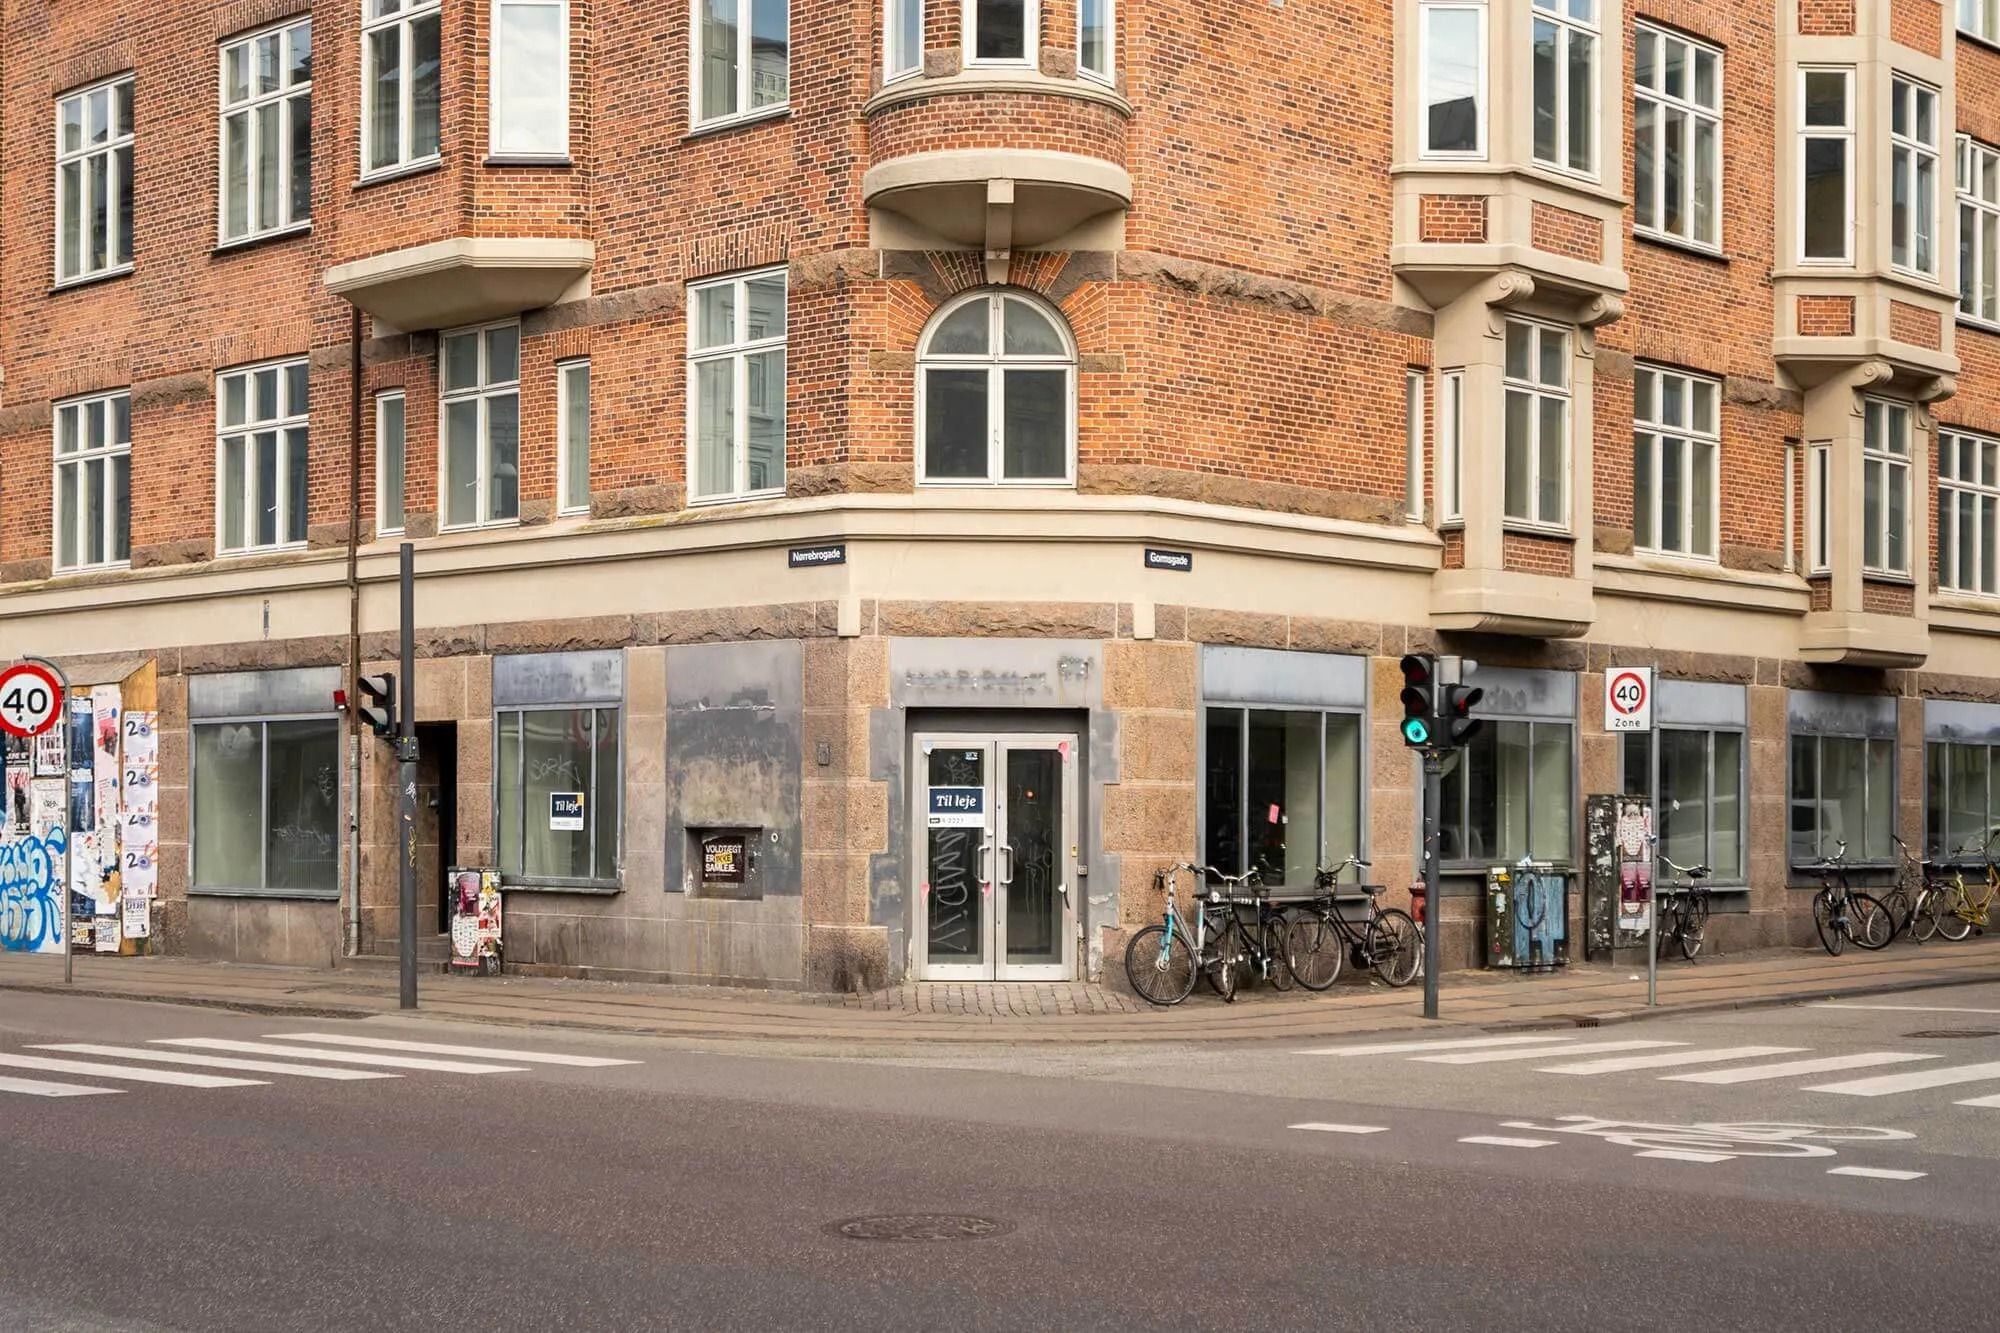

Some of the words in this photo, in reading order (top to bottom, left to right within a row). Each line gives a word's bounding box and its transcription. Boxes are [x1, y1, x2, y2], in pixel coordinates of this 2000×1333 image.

[792, 549, 841, 561] Nørrebrogade
[1616, 685, 1640, 701] 40
[3, 687, 48, 714] 40
[1615, 718, 1641, 728] Zone
[555, 800, 565, 812] Til
[566, 800, 579, 814] leje
[936, 795, 953, 807] Til
[955, 795, 977, 810] leje
